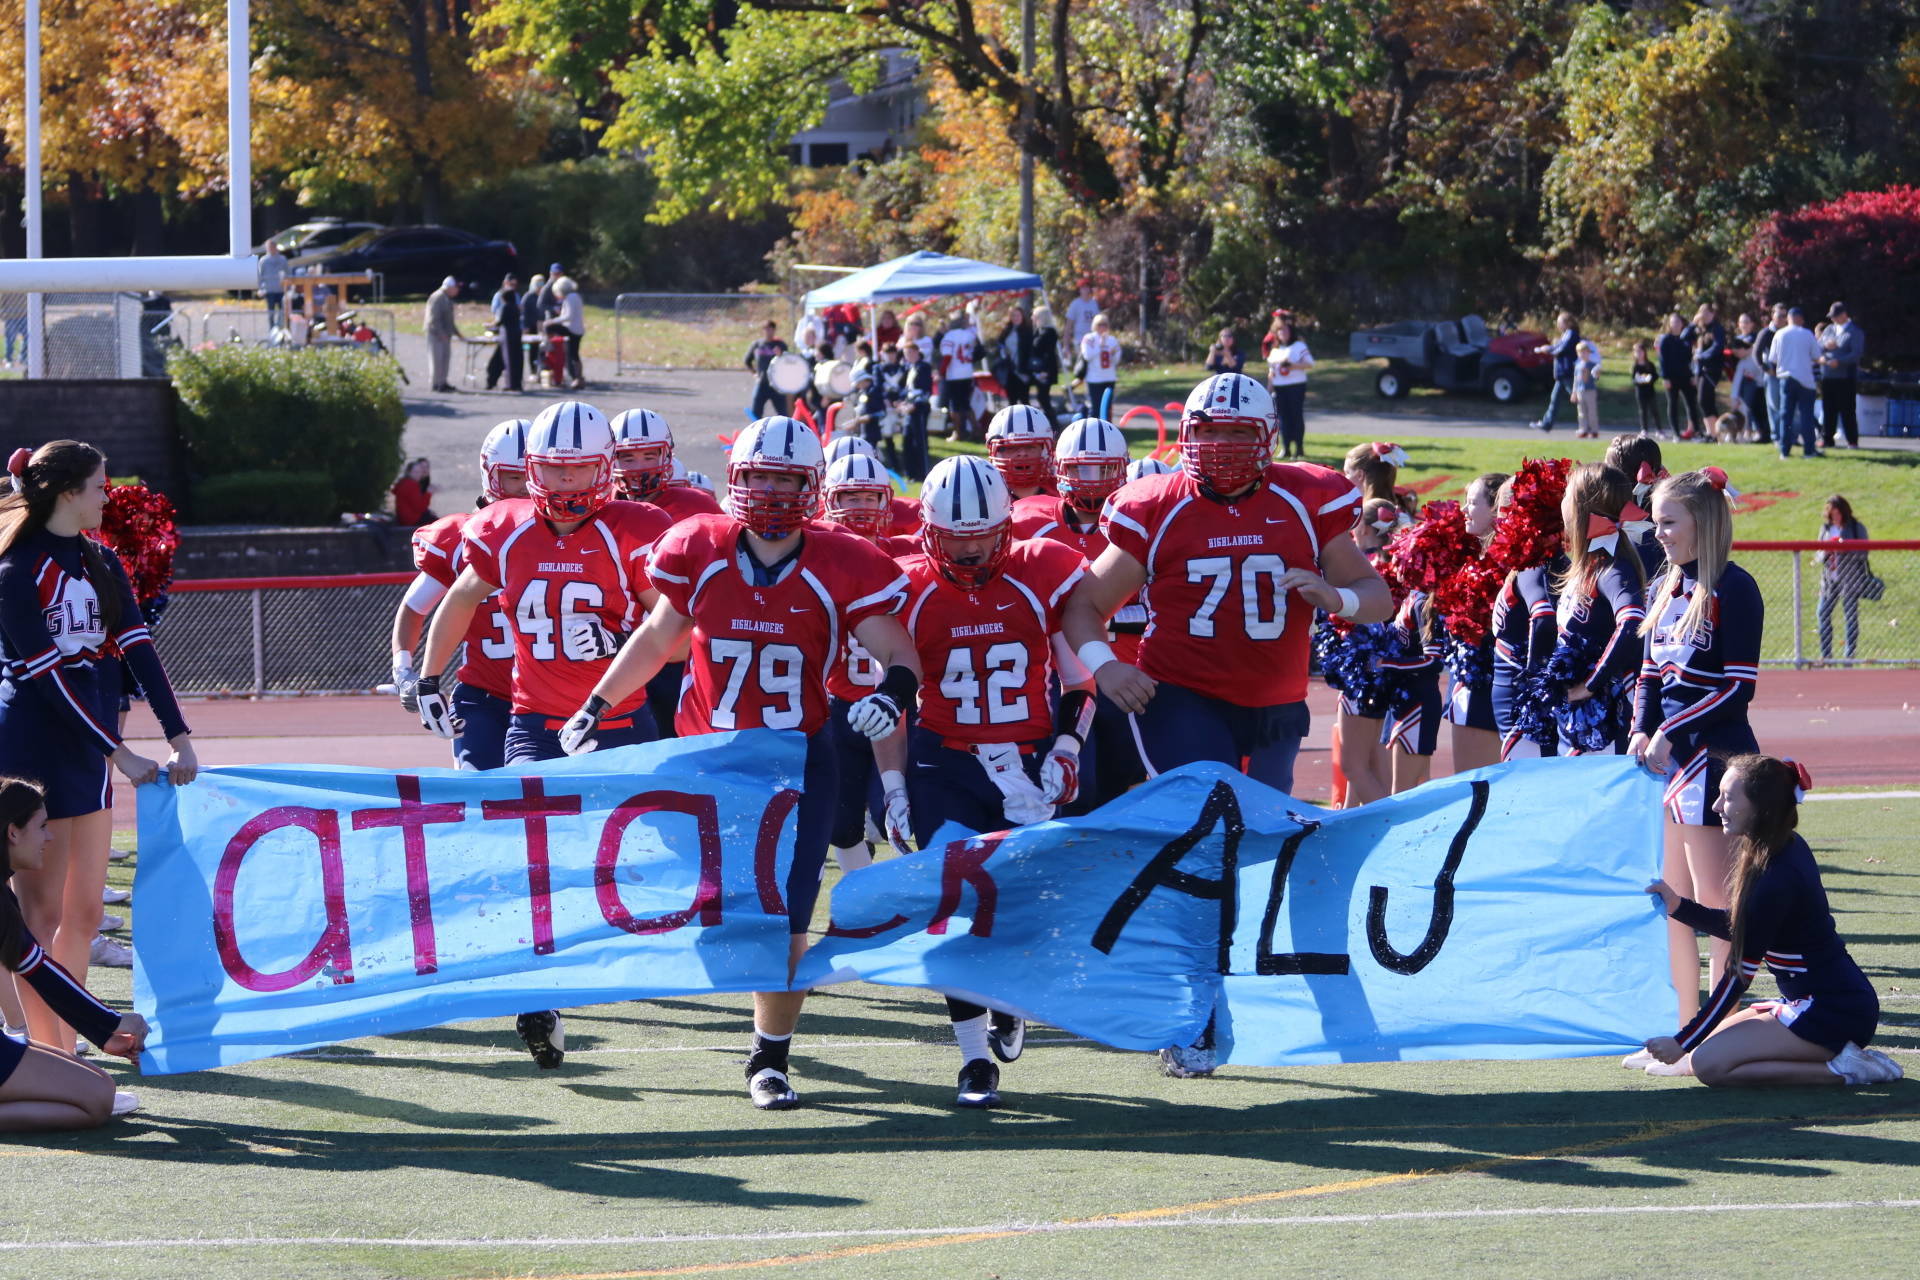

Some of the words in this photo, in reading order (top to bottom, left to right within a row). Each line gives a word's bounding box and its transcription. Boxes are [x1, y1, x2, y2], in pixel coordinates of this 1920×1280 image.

[1208, 535, 1263, 548] HIGHLANDERS
[538, 562, 583, 573] HIGHLANDERS
[516, 579, 603, 661] 46
[1187, 554, 1287, 640] 70
[731, 619, 784, 634] HIGHLANDERS
[951, 623, 1004, 637] HIGHLANDERS
[710, 638, 804, 730] 79
[940, 642, 1030, 724] 42
